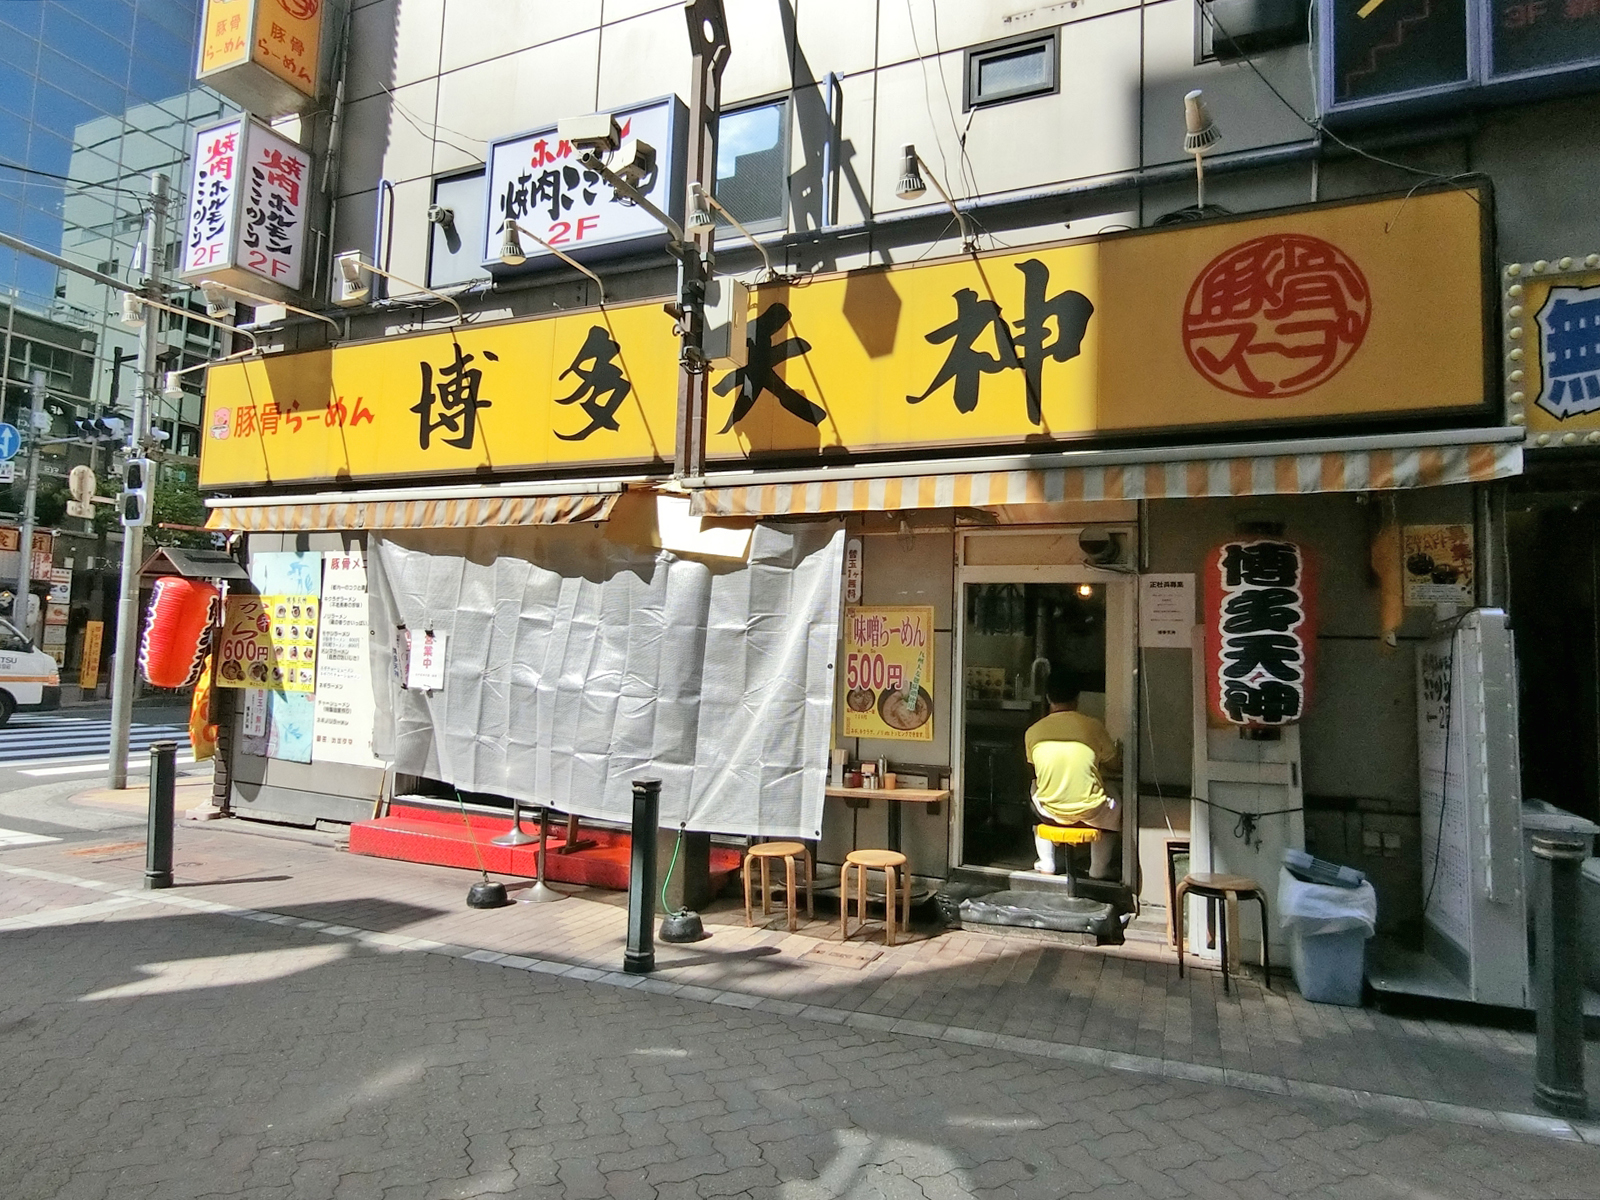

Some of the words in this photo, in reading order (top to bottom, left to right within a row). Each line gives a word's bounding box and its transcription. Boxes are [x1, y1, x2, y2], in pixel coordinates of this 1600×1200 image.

[216, 13, 241, 37] 豚骨
[271, 22, 305, 57] 豚骨
[207, 36, 246, 60] らーめん
[258, 38, 312, 84] らーめん
[204, 131, 239, 180] 焼肉
[258, 148, 306, 207] 焼肉
[206, 179, 231, 241] ホルモン
[265, 192, 298, 255] ホルモン
[548, 215, 600, 245] 2F
[193, 242, 223, 267] 2F
[248, 250, 291, 278] 2F
[410, 258, 1094, 450] 博多天神
[234, 396, 375, 438] 豚骨らーめん
[223, 639, 269, 661] 600円
[853, 614, 926, 648] 味噌らーめん
[1220, 540, 1305, 724] 博多天神
[847, 652, 903, 691] 500円
